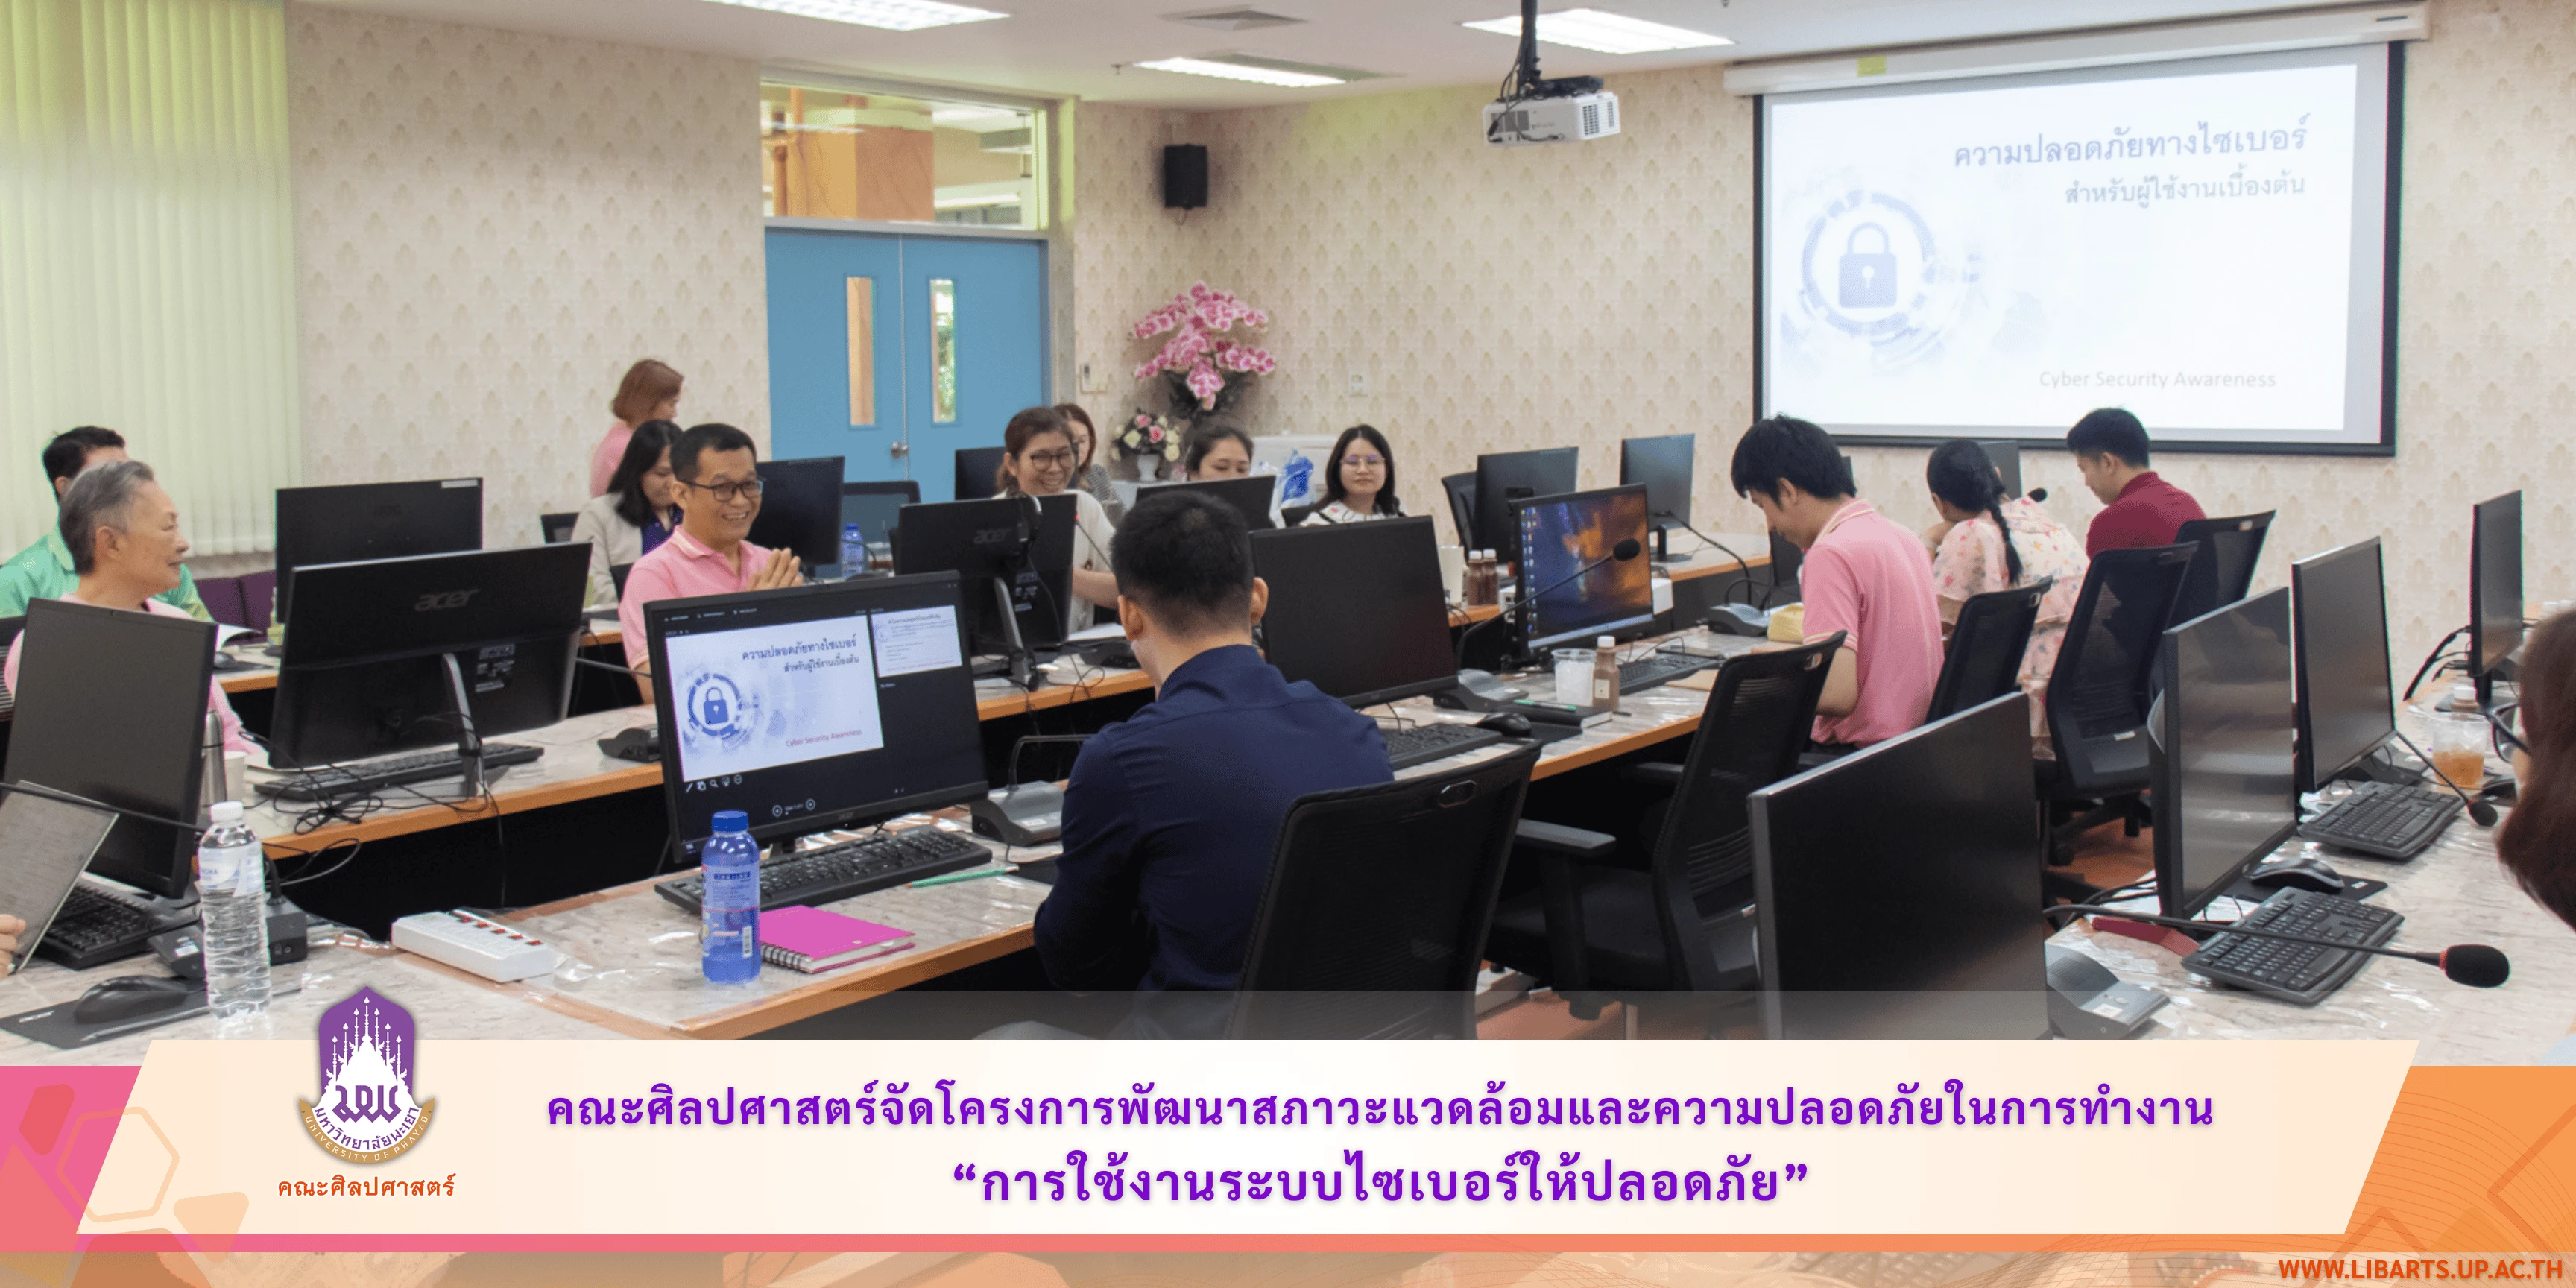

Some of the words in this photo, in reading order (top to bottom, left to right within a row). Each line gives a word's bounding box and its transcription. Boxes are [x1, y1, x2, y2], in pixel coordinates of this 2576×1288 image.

[1954, 113, 2310, 168] ความปลอดภัยทางไซเบอร์
[2065, 163, 2305, 209] สำหรับผู้ใช้งานเบื้องต้น
[2039, 370, 2089, 389] Cyber
[2095, 370, 2168, 389] Security
[2174, 371, 2276, 387] Awareness
[973, 527, 1012, 544] acer
[414, 588, 482, 612] acer
[786, 739, 803, 747] Cyber
[805, 735, 829, 744] Security
[830, 730, 862, 739] Awareness
